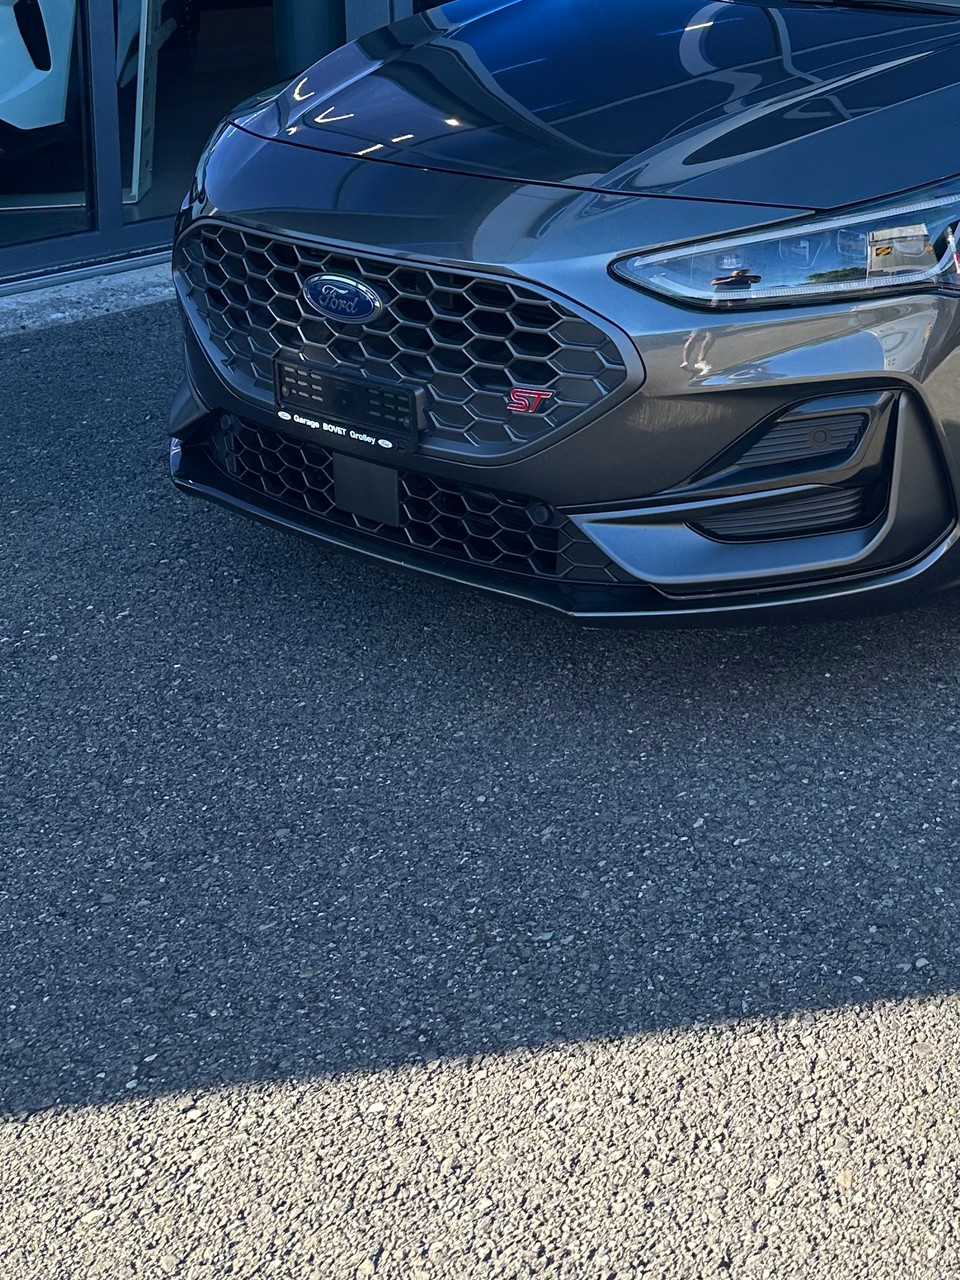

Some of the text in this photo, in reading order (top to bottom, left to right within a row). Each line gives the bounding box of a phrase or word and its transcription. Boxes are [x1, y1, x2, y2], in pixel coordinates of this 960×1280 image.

[319, 284, 359, 313] Ford
[507, 388, 554, 413] ST
[293, 414, 320, 429] Garage
[322, 422, 347, 436] BOVET
[349, 430, 376, 445] Grolley
